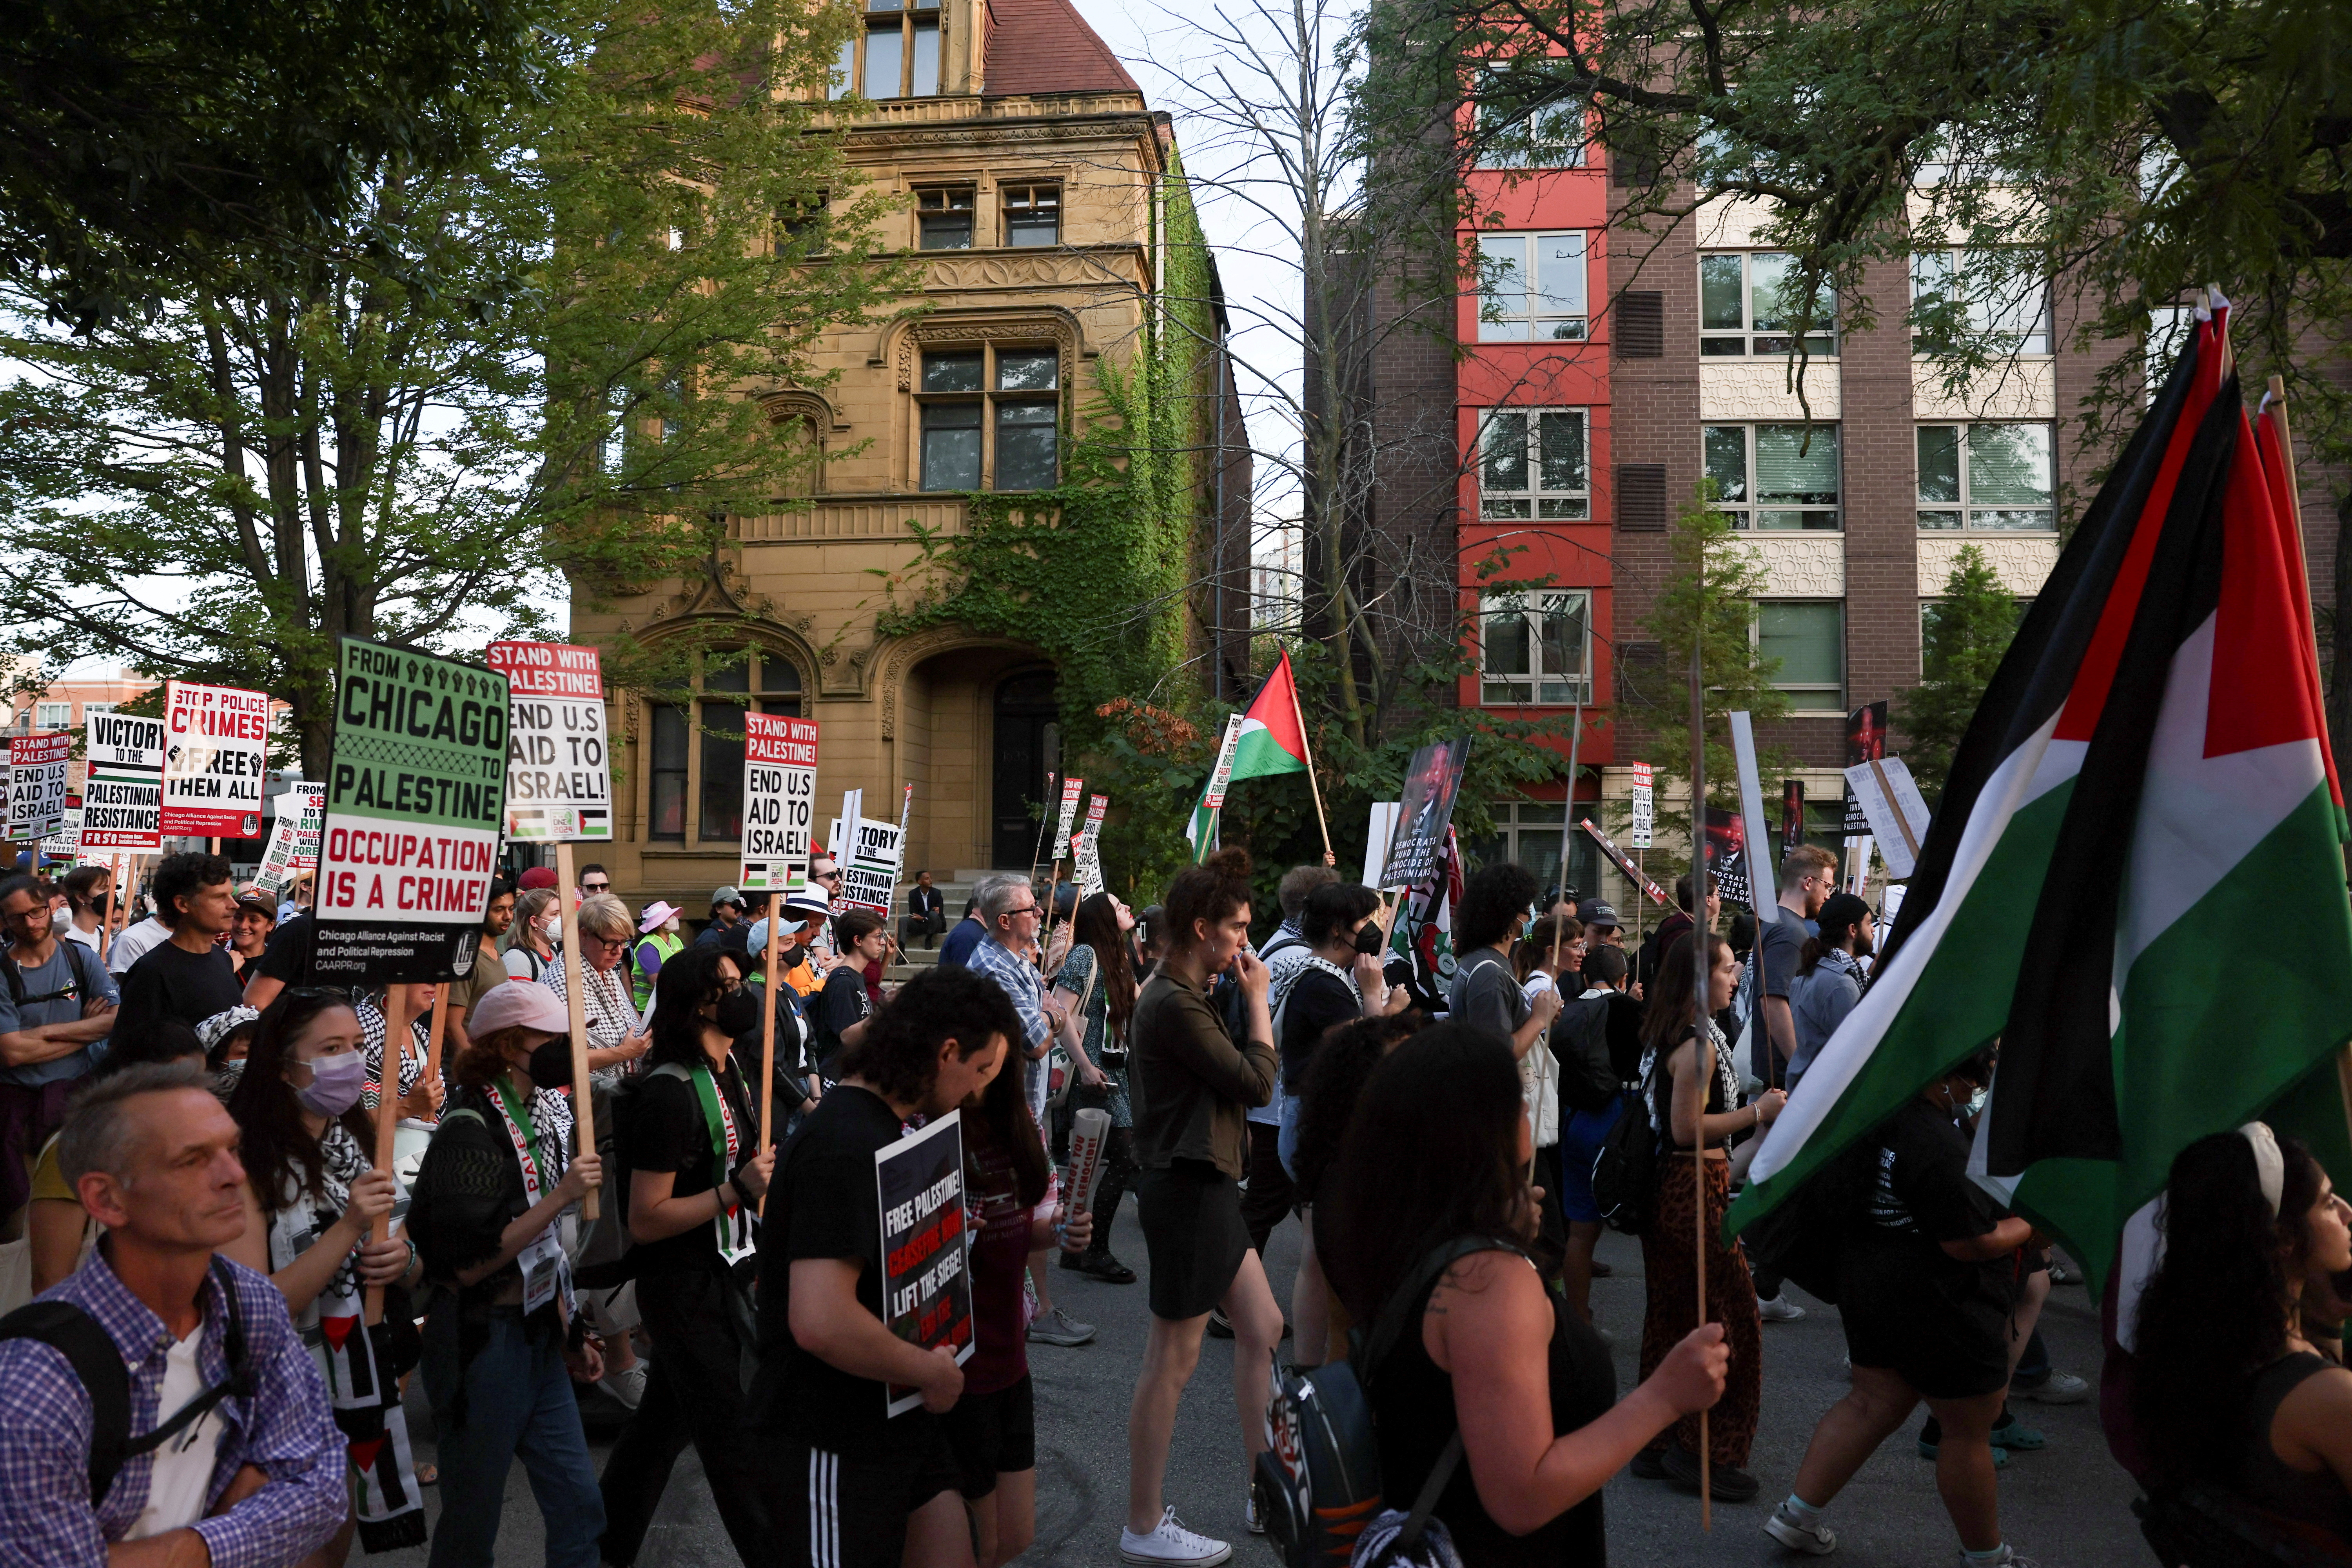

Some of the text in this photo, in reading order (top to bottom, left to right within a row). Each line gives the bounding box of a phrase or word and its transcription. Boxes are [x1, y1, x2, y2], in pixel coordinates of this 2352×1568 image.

[349, 646, 400, 679] FROM
[490, 646, 596, 670] STAND WITH
[174, 690, 264, 713] STOP POLICE
[343, 675, 503, 751] CHICAGO
[510, 704, 598, 731] END U.S
[172, 707, 264, 740] CRIMES
[748, 718, 816, 741] STAND WITH
[95, 717, 164, 750] VICTORY
[13, 735, 69, 750] STAND WITH
[749, 738, 815, 762] PALESTINE!
[1227, 744, 1232, 753] TO
[13, 747, 68, 762] PALESTINE!
[116, 748, 143, 763] TO THE
[510, 735, 601, 766] AID TO
[189, 748, 248, 776] FREE
[481, 756, 500, 780] TO
[1633, 764, 1642, 772] STAND
[15, 765, 64, 783] END U.S
[1634, 776, 1651, 785] PALESTINE!
[167, 776, 221, 798] THEM
[228, 780, 259, 800] ALL
[297, 785, 325, 795] FROM
[510, 771, 604, 799] ISRAEL!
[750, 769, 810, 796] END U.S
[1073, 781, 1082, 789] WITH
[13, 781, 64, 802] AID TO
[87, 784, 161, 806] PALESTINIAN
[333, 764, 499, 821] PALESTINE
[1063, 789, 1080, 799] PALESTINE!
[1091, 797, 1103, 806] STAND
[12, 799, 62, 820] ISRAEL!
[303, 808, 315, 817] TO
[748, 798, 808, 826] AID TO
[1643, 804, 1651, 817] TO
[84, 807, 160, 830] RESISTANCE
[278, 816, 294, 828] FROM
[1067, 816, 1072, 828] TO
[1634, 818, 1650, 831] ISRAEL!
[281, 829, 292, 842] SEA
[1056, 830, 1069, 842] ISRAEL!
[1085, 822, 1095, 835] END
[50, 836, 76, 844] POLICE
[275, 840, 290, 853] TO THE
[748, 829, 807, 855] ISRAEL!
[1072, 834, 1083, 846] STAN
[1082, 837, 1092, 850] AID
[1395, 837, 1437, 850] DEMOCRATS
[270, 850, 287, 866] RIVER
[328, 828, 492, 873] OCCUPATION
[864, 846, 877, 857] THE
[1395, 848, 1430, 860] FUND THE
[1078, 853, 1093, 865] ISRAE
[1091, 859, 1097, 871] TO
[1388, 857, 1433, 871] GENOCIDE OF
[265, 870, 273, 879] WILL
[266, 862, 284, 874] PALESTINE
[1383, 867, 1431, 882] PALESTINIANS
[1082, 871, 1100, 893] ISRAEL!
[326, 871, 486, 912] IS A CRIME!
[319, 930, 445, 943] Chicago Alliance Against Racist
[317, 947, 414, 958] and Political Repression
[316, 960, 365, 972] CAARPR.org
[1064, 1135, 1085, 1206] CHARGE YOU
[1077, 1138, 1098, 1198] GENOCIDE!
[886, 1169, 961, 1238] FREE PALESTINE!
[894, 1247, 962, 1318] LIFT THE SIEGE!
